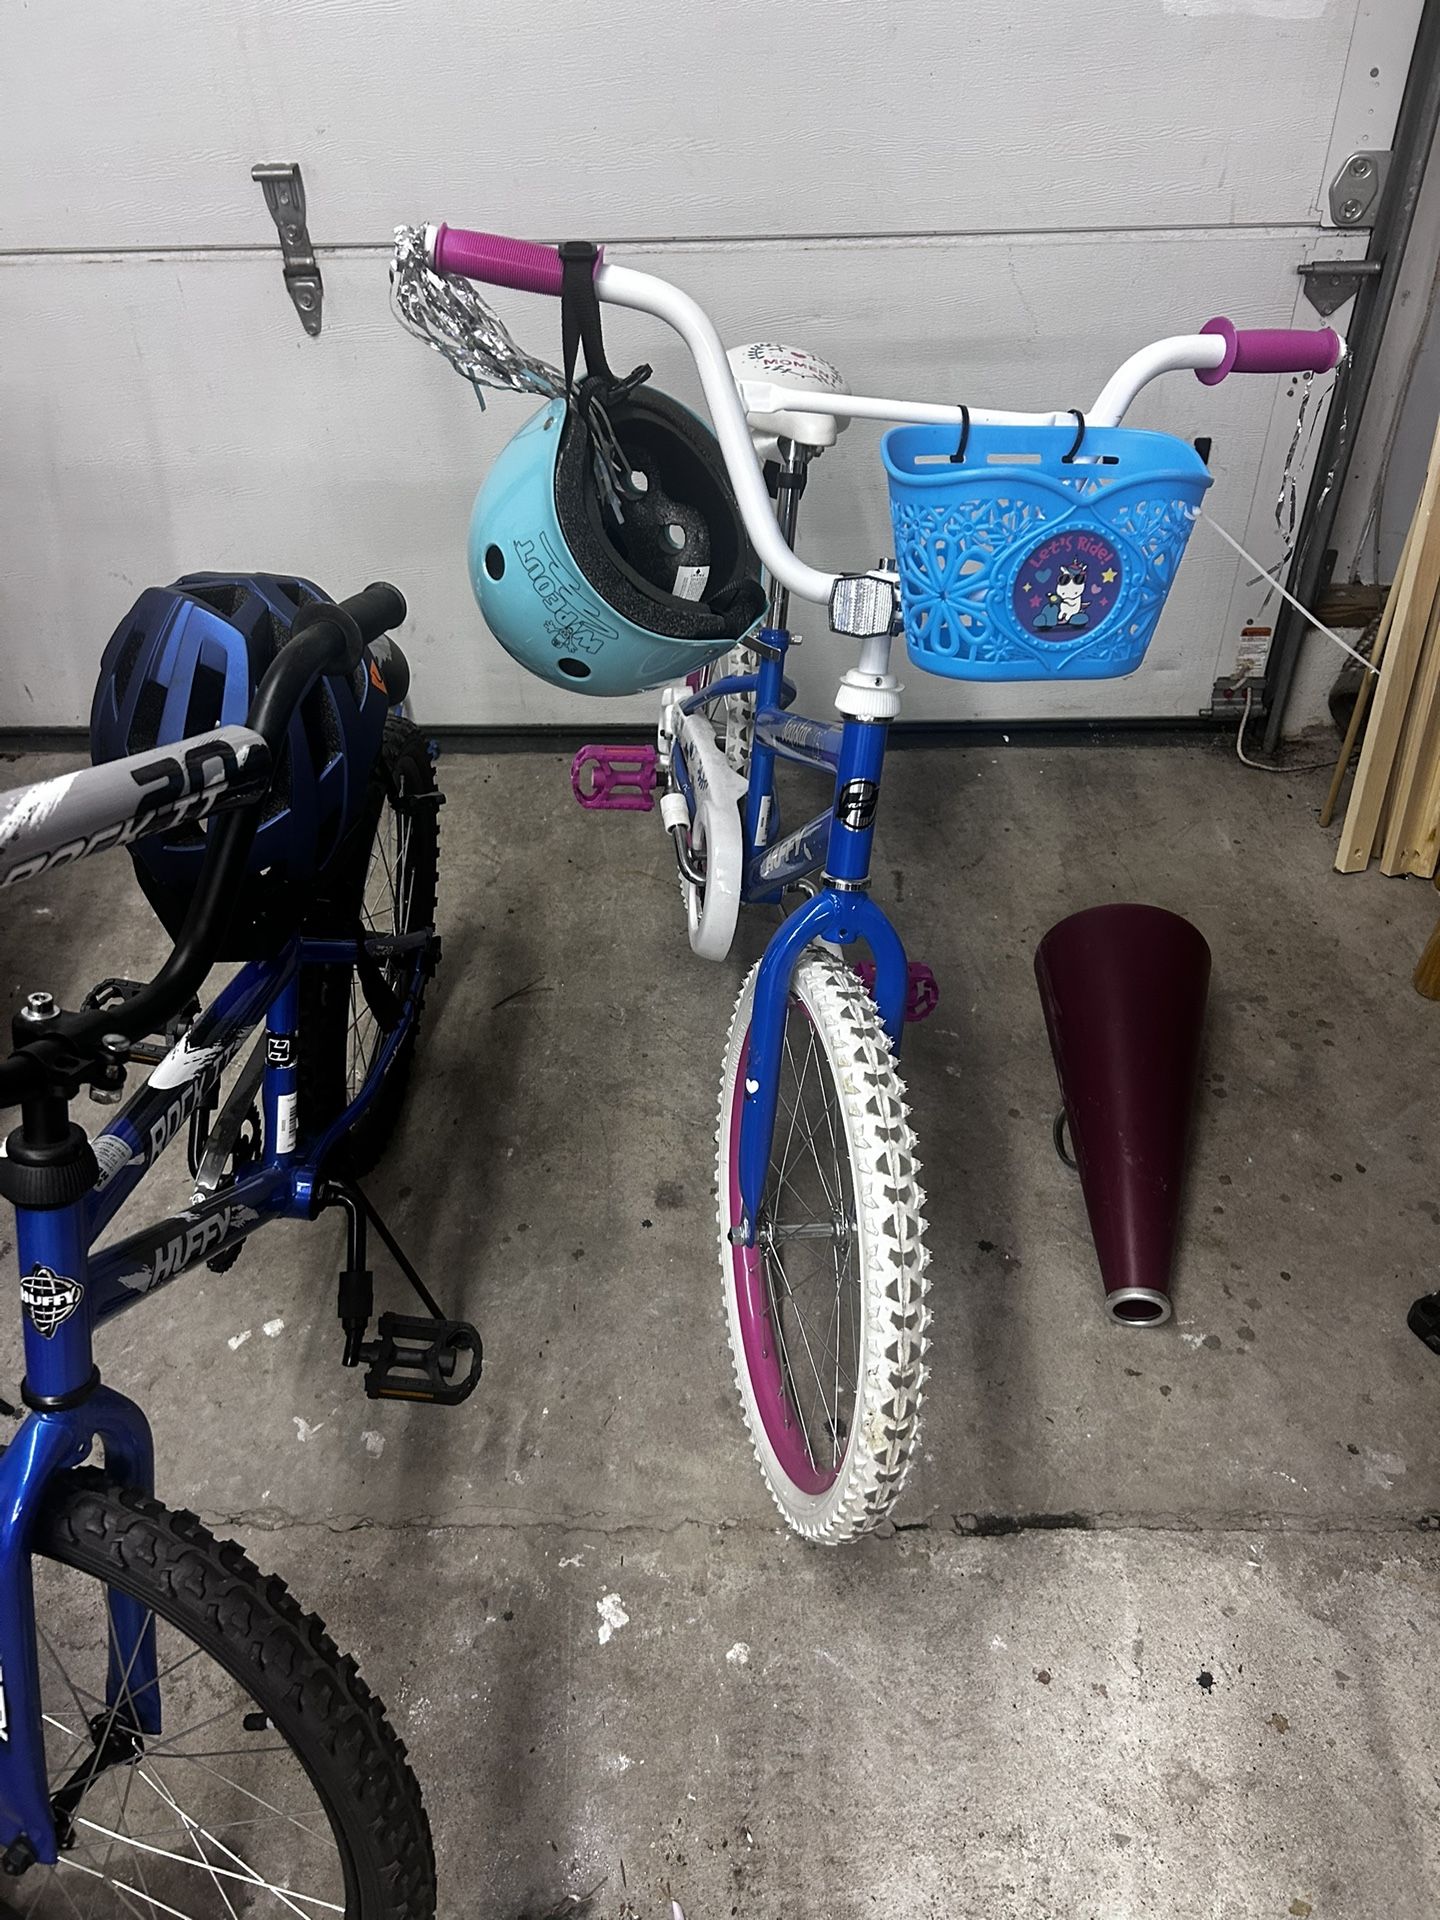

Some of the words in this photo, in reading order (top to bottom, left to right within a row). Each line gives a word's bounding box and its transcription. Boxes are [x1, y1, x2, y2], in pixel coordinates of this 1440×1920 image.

[1077, 536, 1114, 565] Ride!
[513, 539, 604, 655] WIPEOUT
[149, 1205, 231, 1289] HUFFY
[20, 1286, 77, 1306] HUFFY
